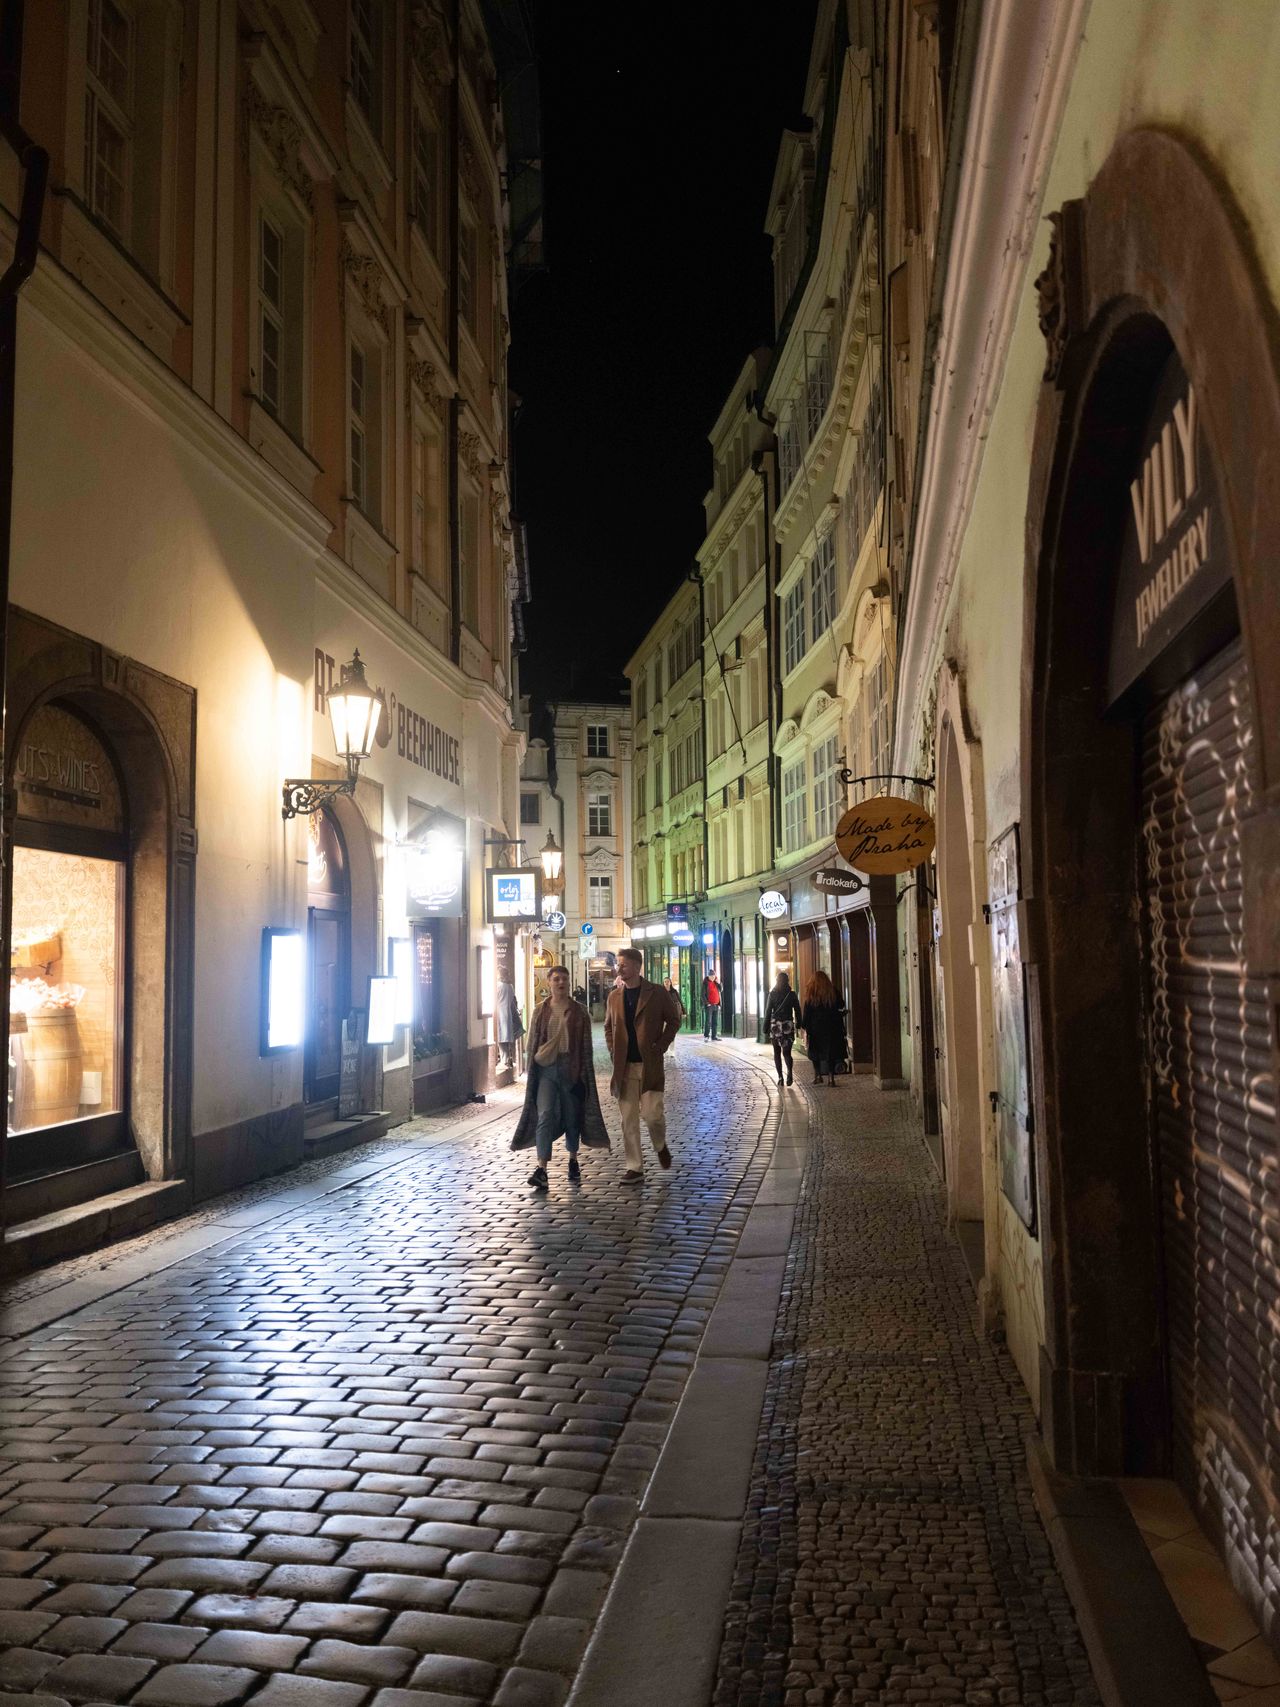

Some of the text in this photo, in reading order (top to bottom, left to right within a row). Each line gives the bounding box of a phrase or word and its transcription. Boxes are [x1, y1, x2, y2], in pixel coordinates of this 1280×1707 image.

[1131, 382, 1197, 565] VILY
[1136, 506, 1209, 648] JEWELLERY
[397, 702, 460, 786] BEERHOUSE
[58, 751, 100, 794] WINES
[837, 813, 929, 839] Made by
[849, 834, 926, 862] Praha
[500, 881, 519, 901] orloj
[816, 871, 858, 889] Trdlokafe
[760, 894, 784, 911] local
